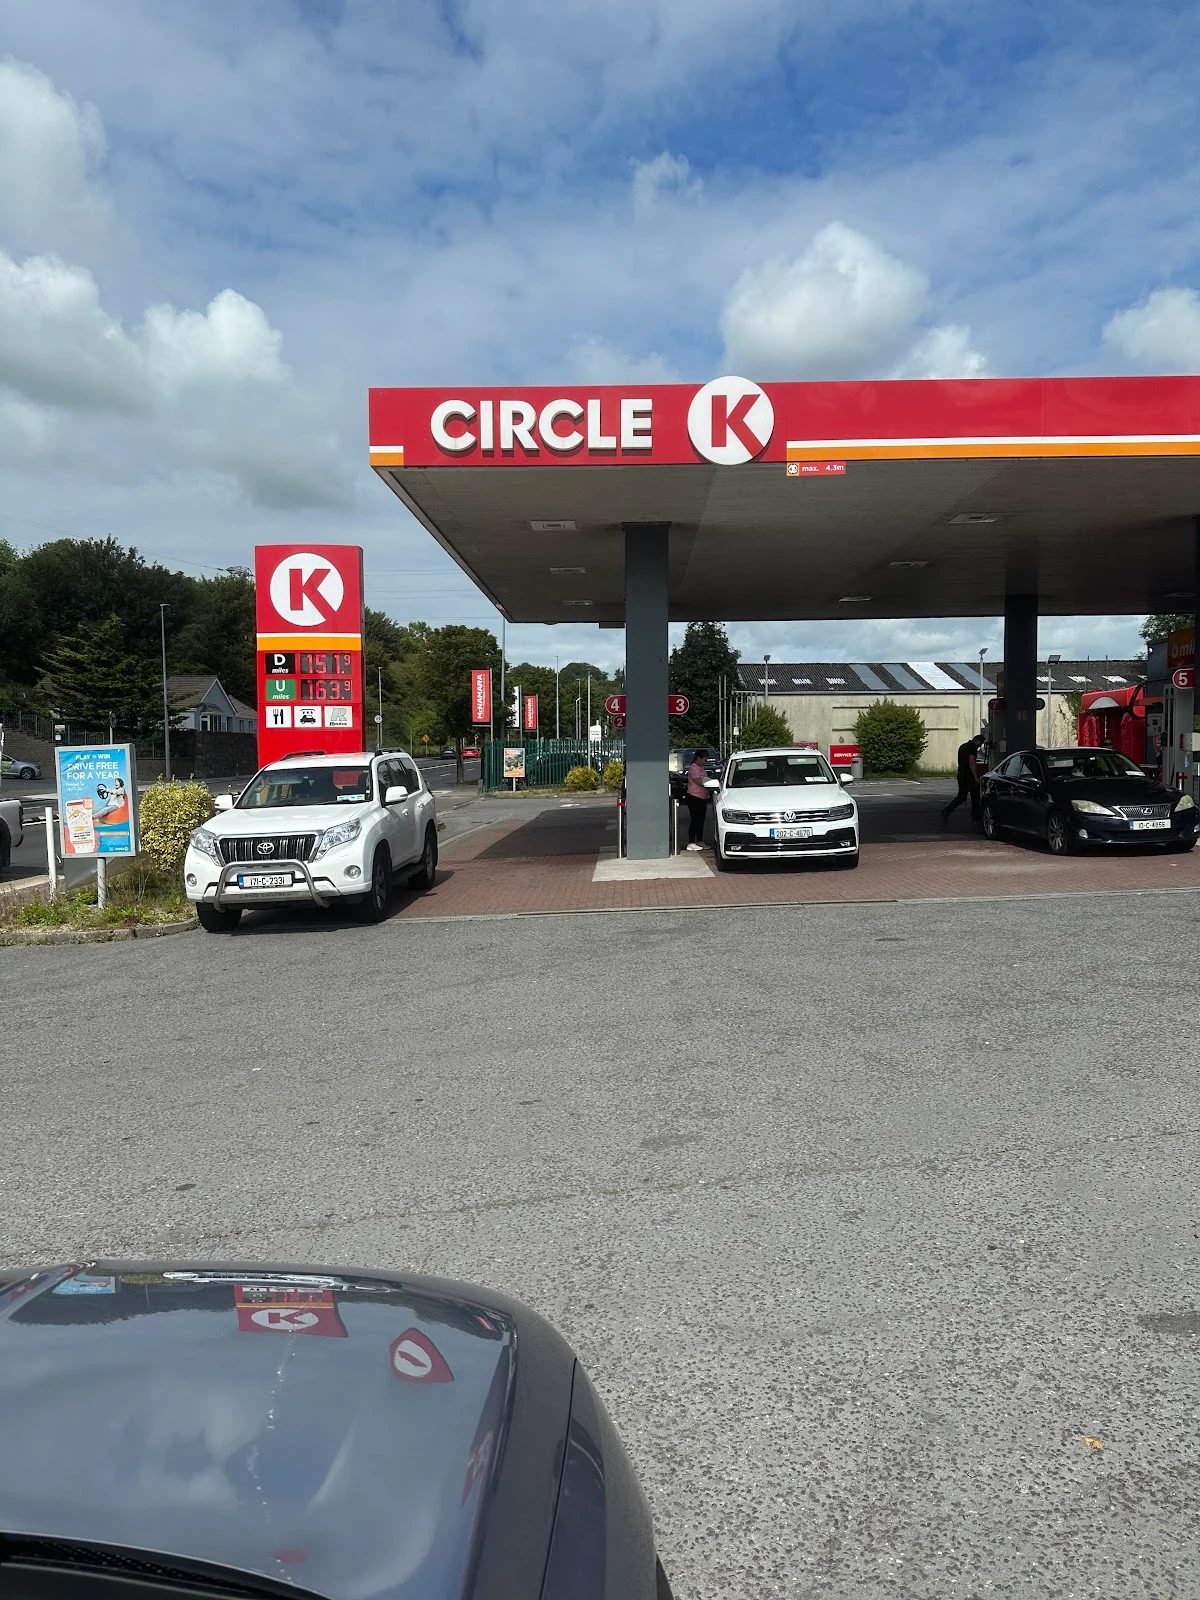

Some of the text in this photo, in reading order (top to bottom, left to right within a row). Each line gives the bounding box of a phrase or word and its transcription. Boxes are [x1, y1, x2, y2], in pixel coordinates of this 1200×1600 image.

[430, 393, 765, 458] CIRCLE K
[288, 568, 338, 621] K
[273, 653, 286, 666] D
[275, 679, 286, 692] U
[1178, 672, 1188, 686] 5
[610, 698, 620, 711] 4
[675, 698, 685, 712] 3
[616, 718, 623, 727] 2
[67, 761, 119, 771] DRIVE FREE
[66, 771, 120, 780] FOR A YEAR
